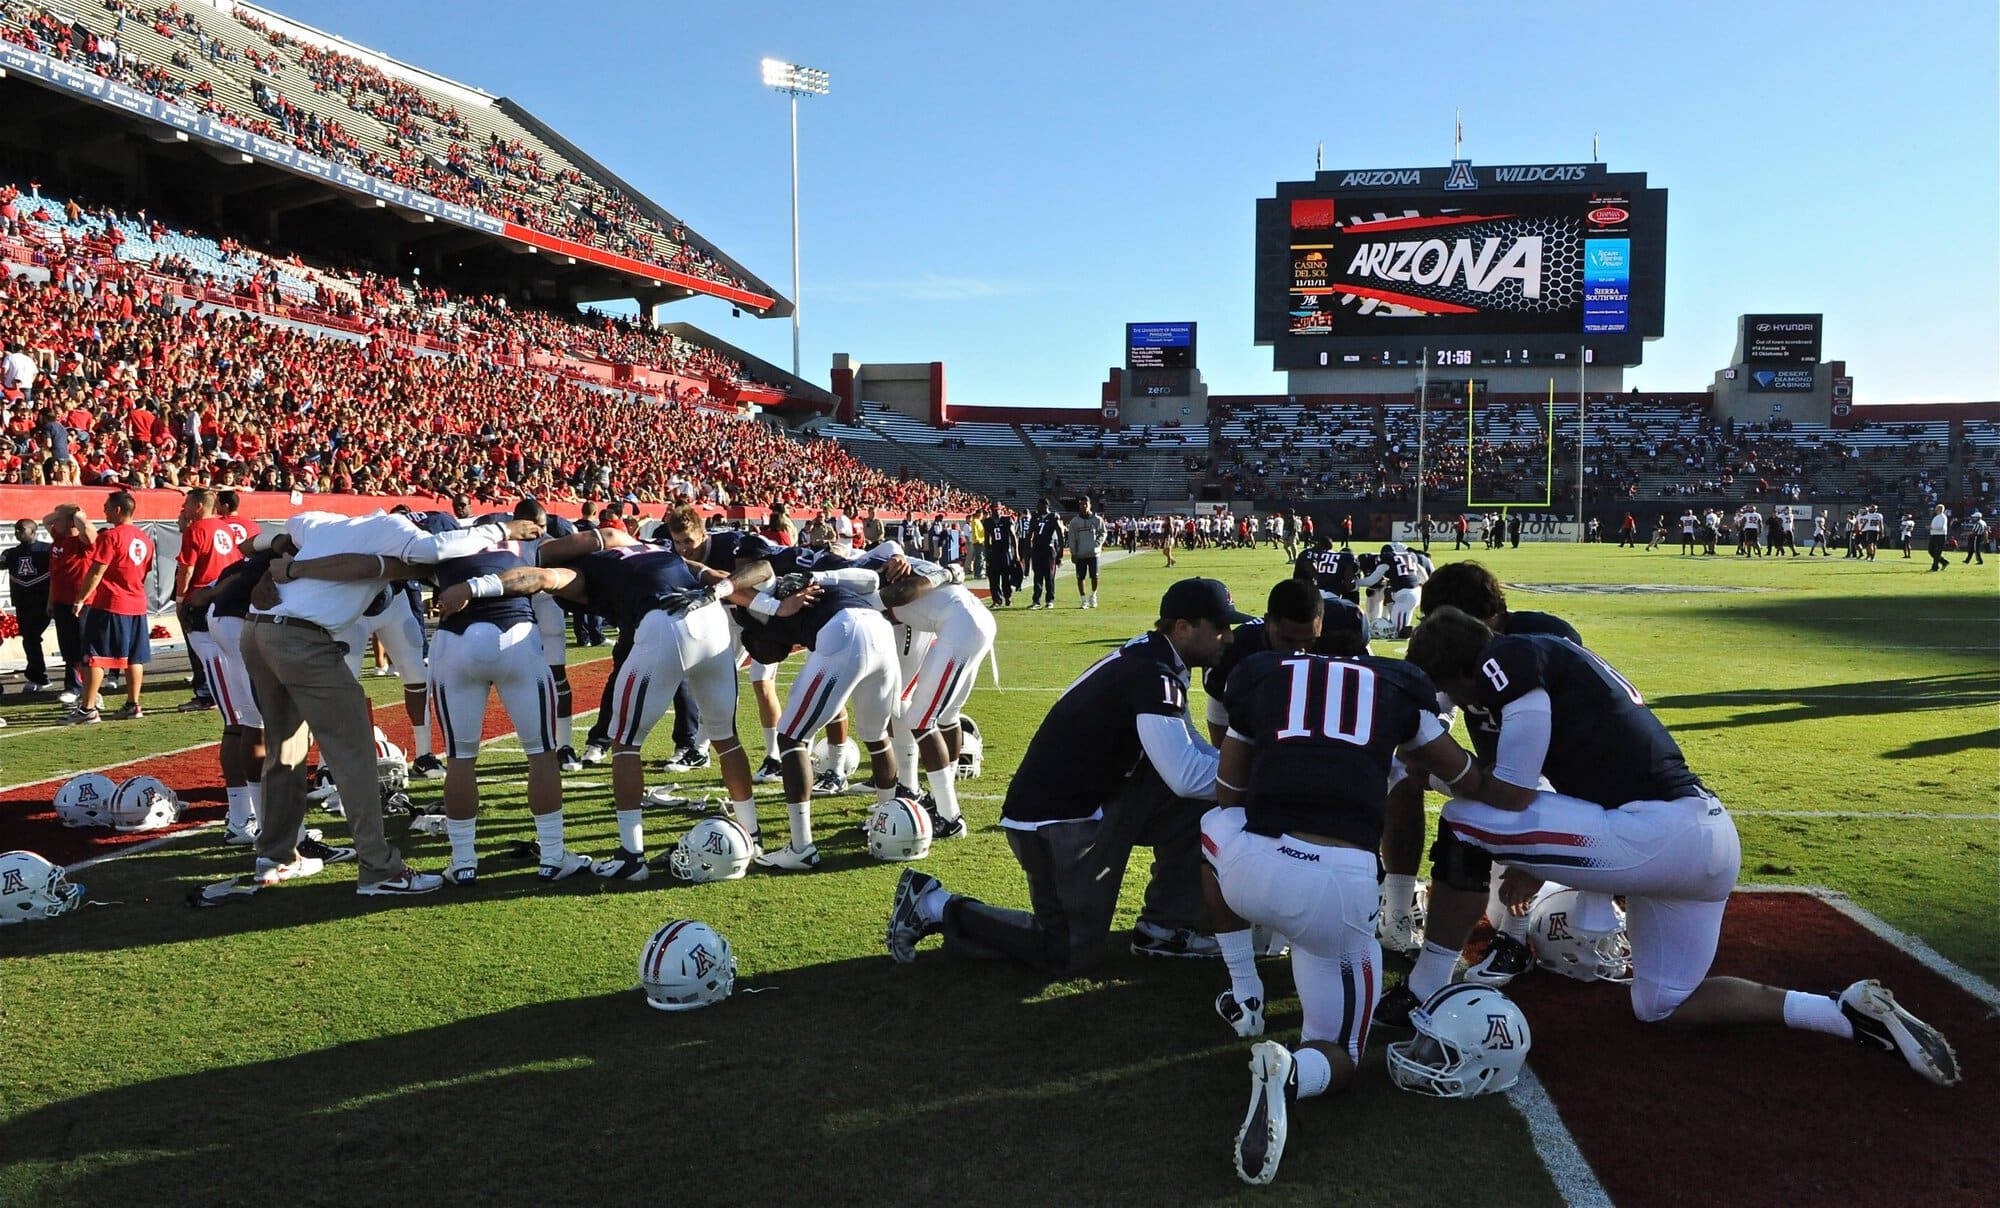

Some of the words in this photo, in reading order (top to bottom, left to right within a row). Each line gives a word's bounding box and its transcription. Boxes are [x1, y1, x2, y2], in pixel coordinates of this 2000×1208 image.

[1340, 170, 1420, 187] ARIZONA
[1495, 166, 1586, 183] WILDCATS
[1294, 261, 1327, 269] CASINO
[1312, 269, 1328, 277] SOL
[1347, 235, 1542, 299] ARIZONA
[1773, 323, 1813, 331] HYUNDAI
[1320, 352, 1328, 365] 0
[1437, 350, 1472, 365] 21:56
[1585, 349, 1593, 363] 0
[1148, 386, 1170, 394] zero
[1038, 522, 1046, 535] 7
[1318, 553, 1341, 574] 25
[1393, 555, 1419, 576] 24
[1482, 657, 1509, 692] 8
[1277, 659, 1375, 746] 10
[1276, 845, 1320, 862] ARIZONA
[3, 868, 28, 895] A
[458, 869, 475, 880] NIKE
[1547, 911, 1574, 941] A
[1482, 1014, 1514, 1050] A
